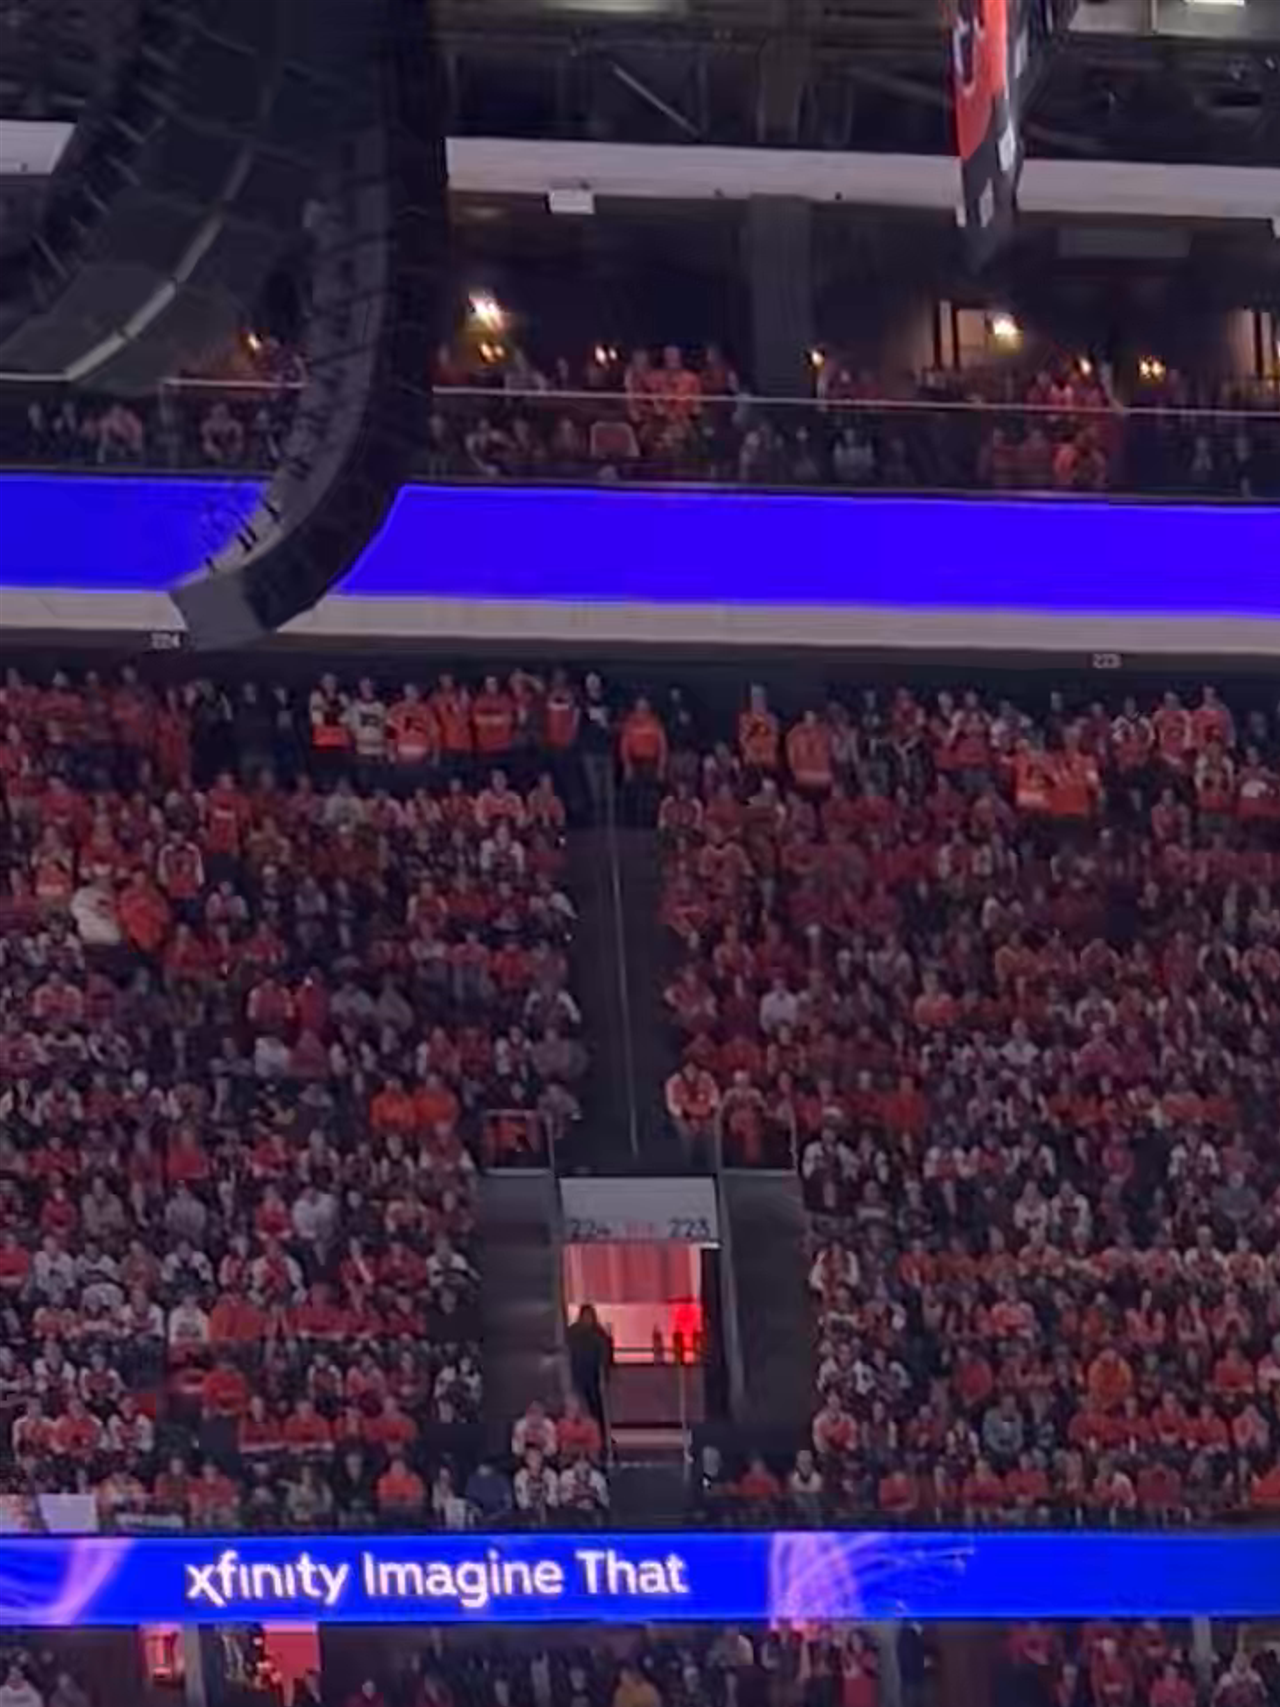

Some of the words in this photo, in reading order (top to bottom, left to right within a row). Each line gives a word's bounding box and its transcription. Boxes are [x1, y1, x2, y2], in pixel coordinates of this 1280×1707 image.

[186, 1549, 350, 1607] xfinity
[363, 1550, 565, 1609] Imagine
[575, 1550, 690, 1596] That
